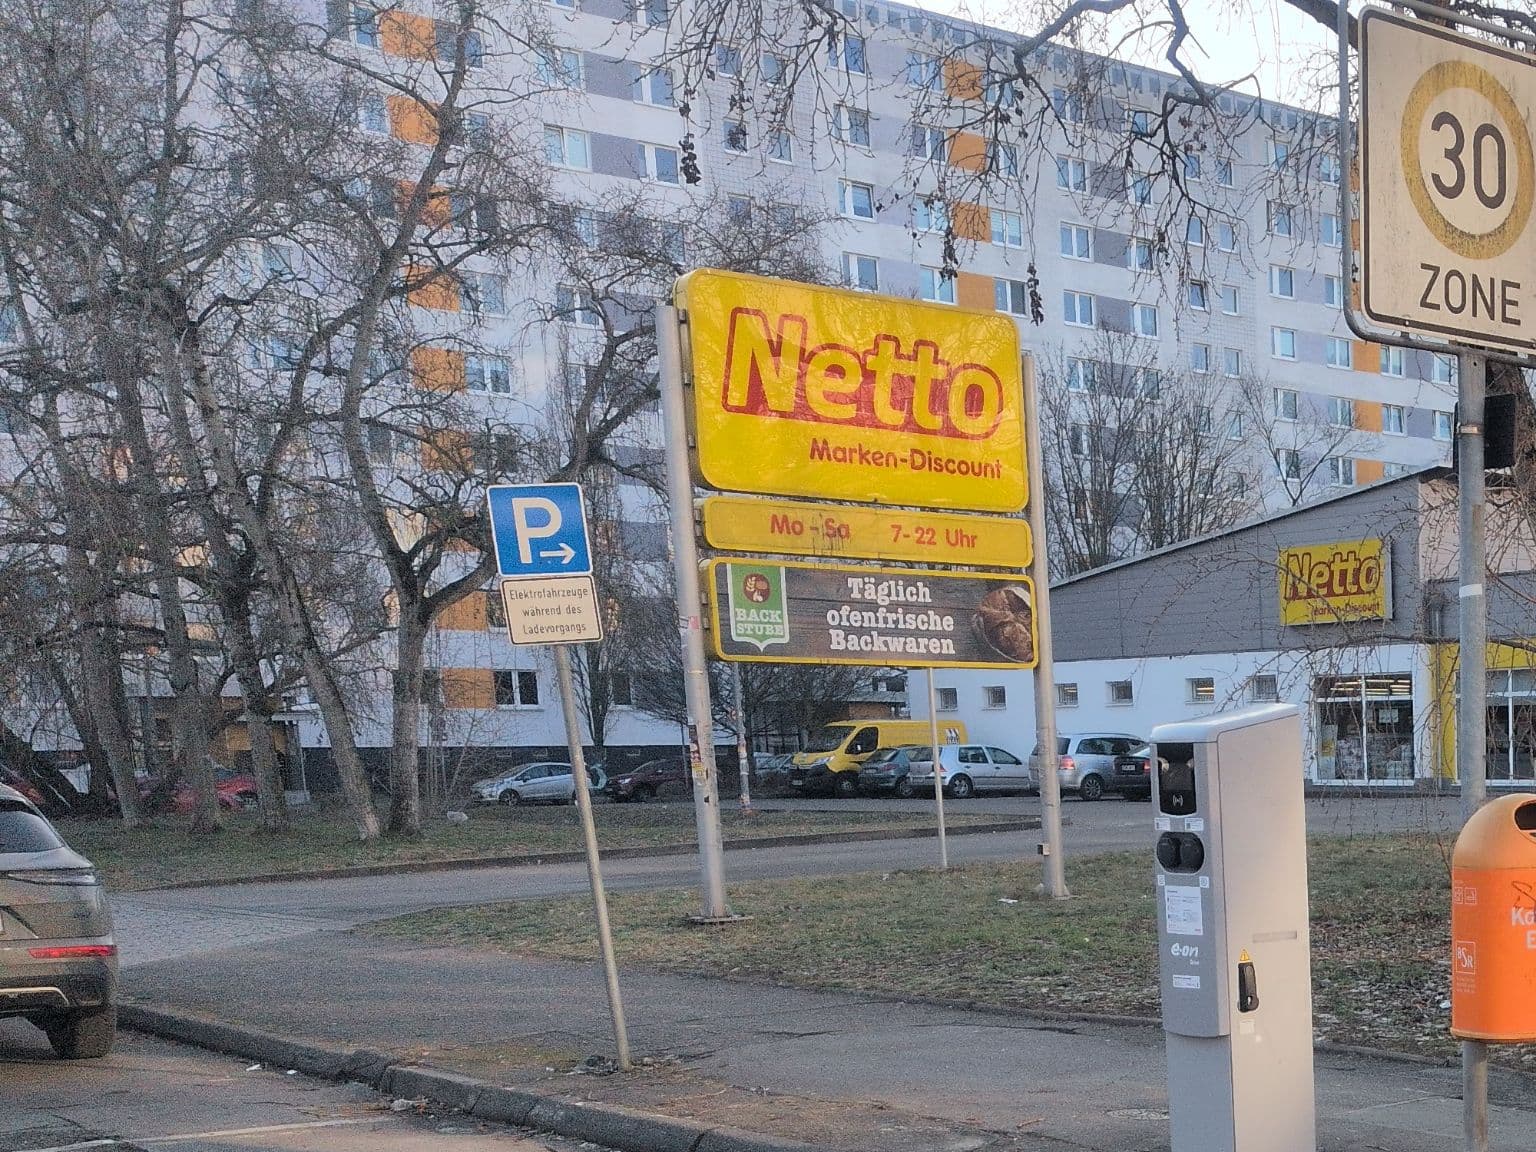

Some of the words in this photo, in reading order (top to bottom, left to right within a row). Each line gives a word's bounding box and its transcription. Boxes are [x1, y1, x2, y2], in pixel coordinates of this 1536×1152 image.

[1430, 110, 1507, 209] 30
[1419, 262, 1521, 326] ZONE
[721, 307, 1004, 441] Netto
[809, 437, 1003, 480] Marken-Discount
[511, 497, 563, 564] P
[770, 513, 804, 537] Mo
[824, 517, 850, 539] Sa
[945, 528, 978, 549] Uhr
[1284, 550, 1381, 600] Netto
[509, 587, 589, 600] Elektrofahrzeuge
[847, 577, 932, 605] Täglich
[566, 604, 583, 615] des
[734, 607, 782, 623] BACK
[826, 605, 955, 632] ofenfrische
[522, 622, 587, 636] Ladevorgangs
[736, 623, 784, 637] STUBE
[829, 629, 956, 655] Backwaren
[1457, 946, 1474, 969] BSR
